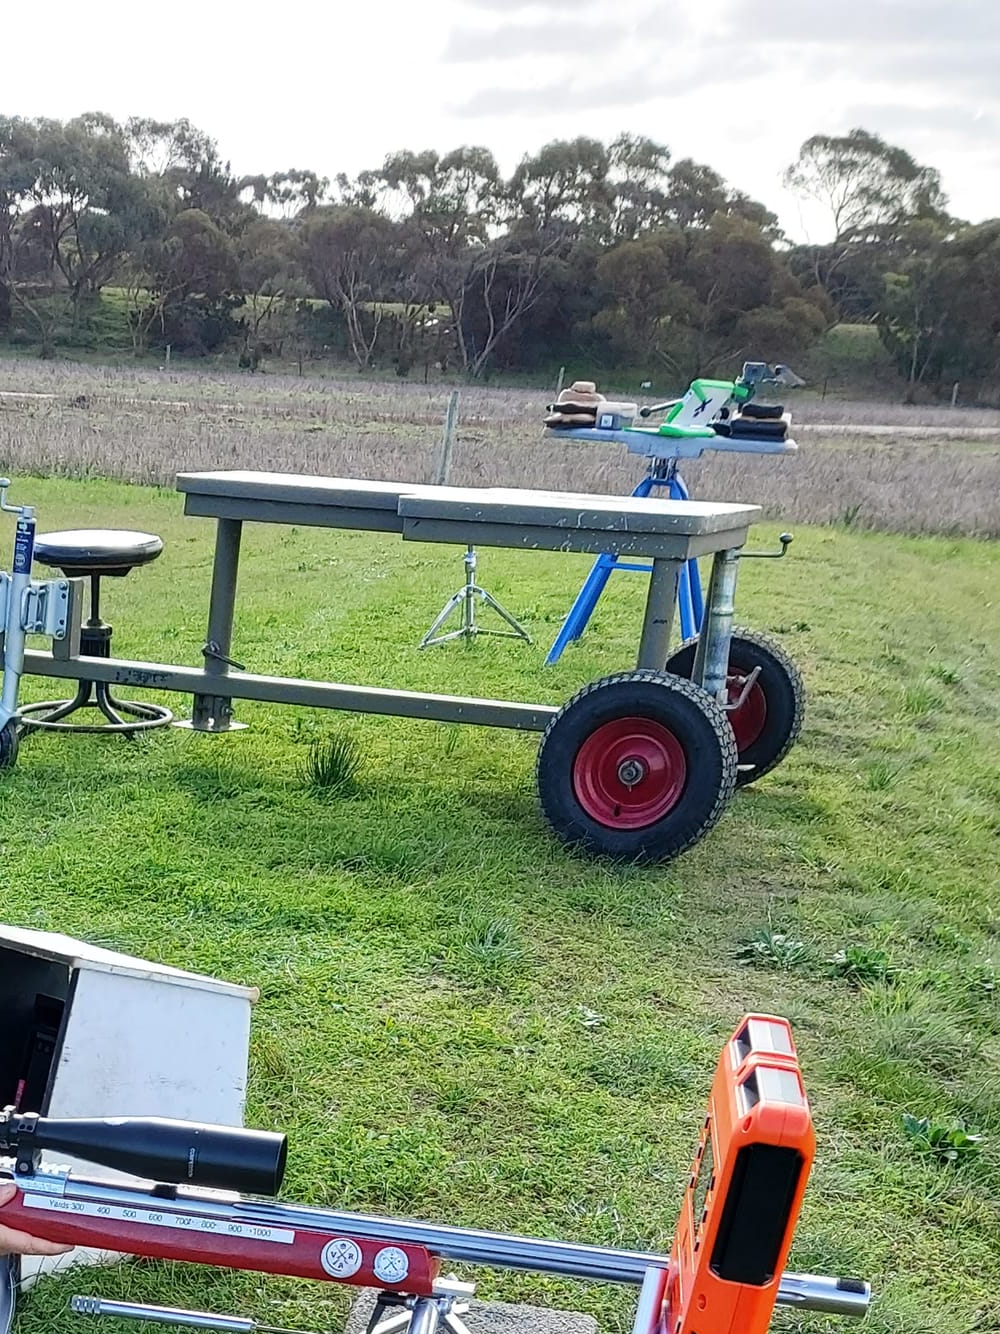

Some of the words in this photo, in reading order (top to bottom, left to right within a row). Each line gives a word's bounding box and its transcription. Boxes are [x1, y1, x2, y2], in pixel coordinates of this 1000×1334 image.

[49, 1199, 69, 1210] Yards
[96, 1207, 110, 1215] 400
[122, 1209, 137, 1218] 500
